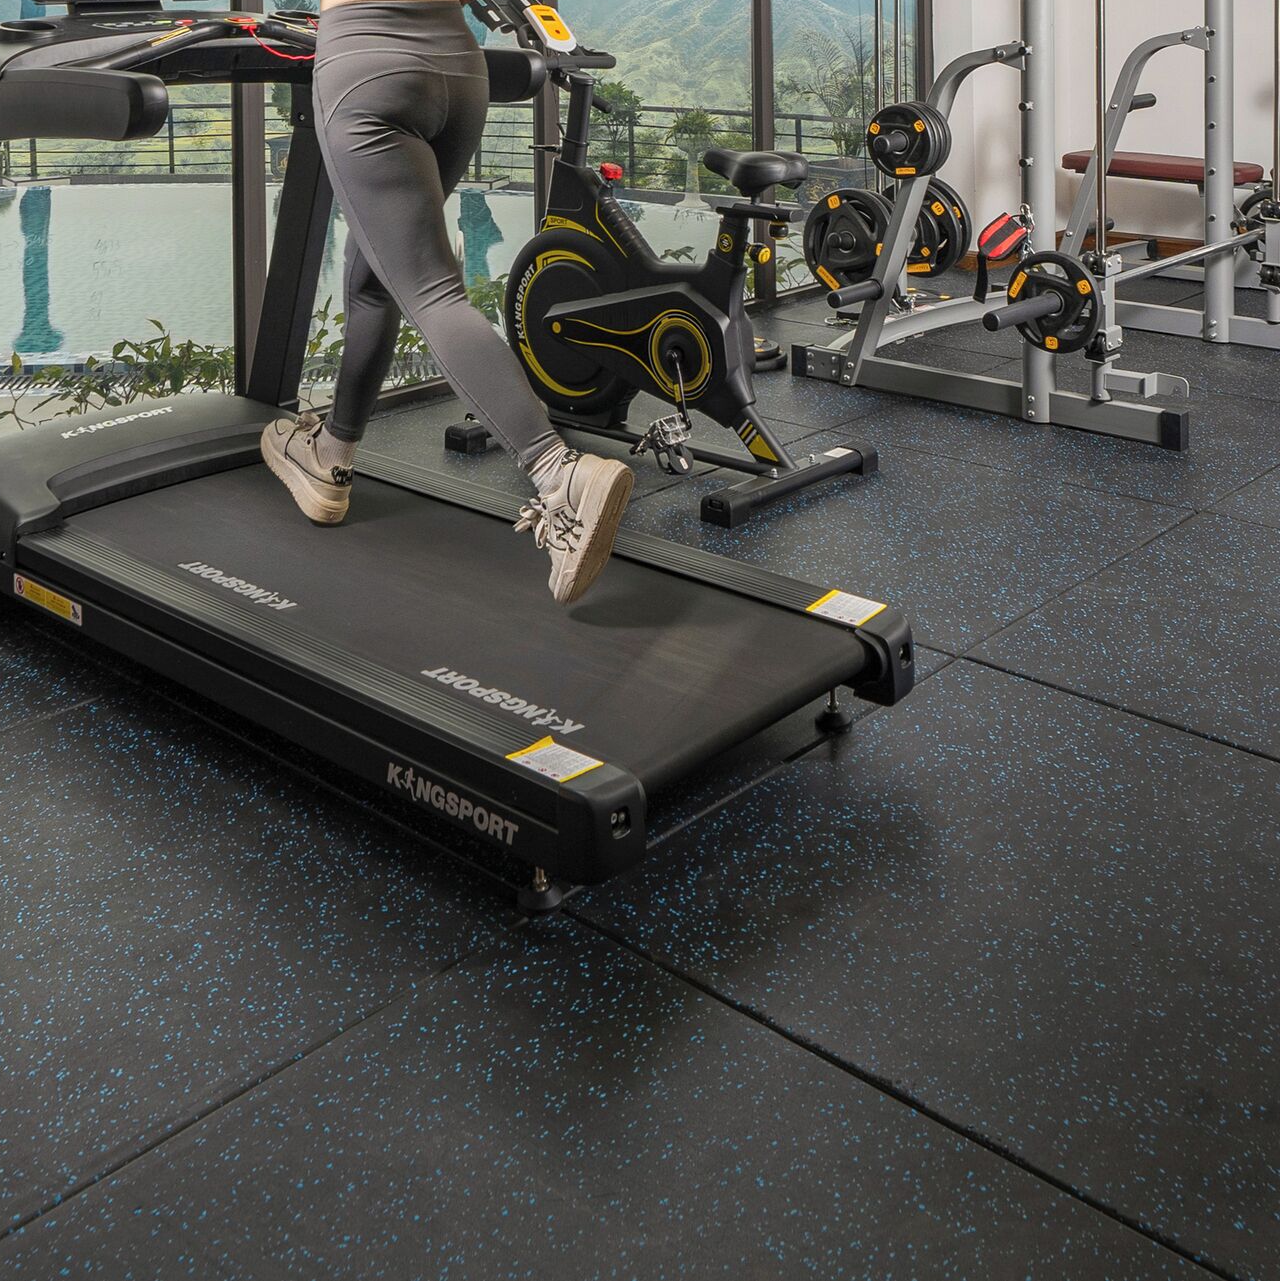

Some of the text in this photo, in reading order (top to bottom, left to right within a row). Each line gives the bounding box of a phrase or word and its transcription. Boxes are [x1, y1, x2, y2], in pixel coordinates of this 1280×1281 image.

[549, 216, 568, 225] SPORT
[60, 405, 174, 440] KINGSPORT
[178, 559, 298, 611] KINGSPORT
[420, 665, 585, 735] KINGSPORT
[385, 762, 520, 847] KINGSPORT
